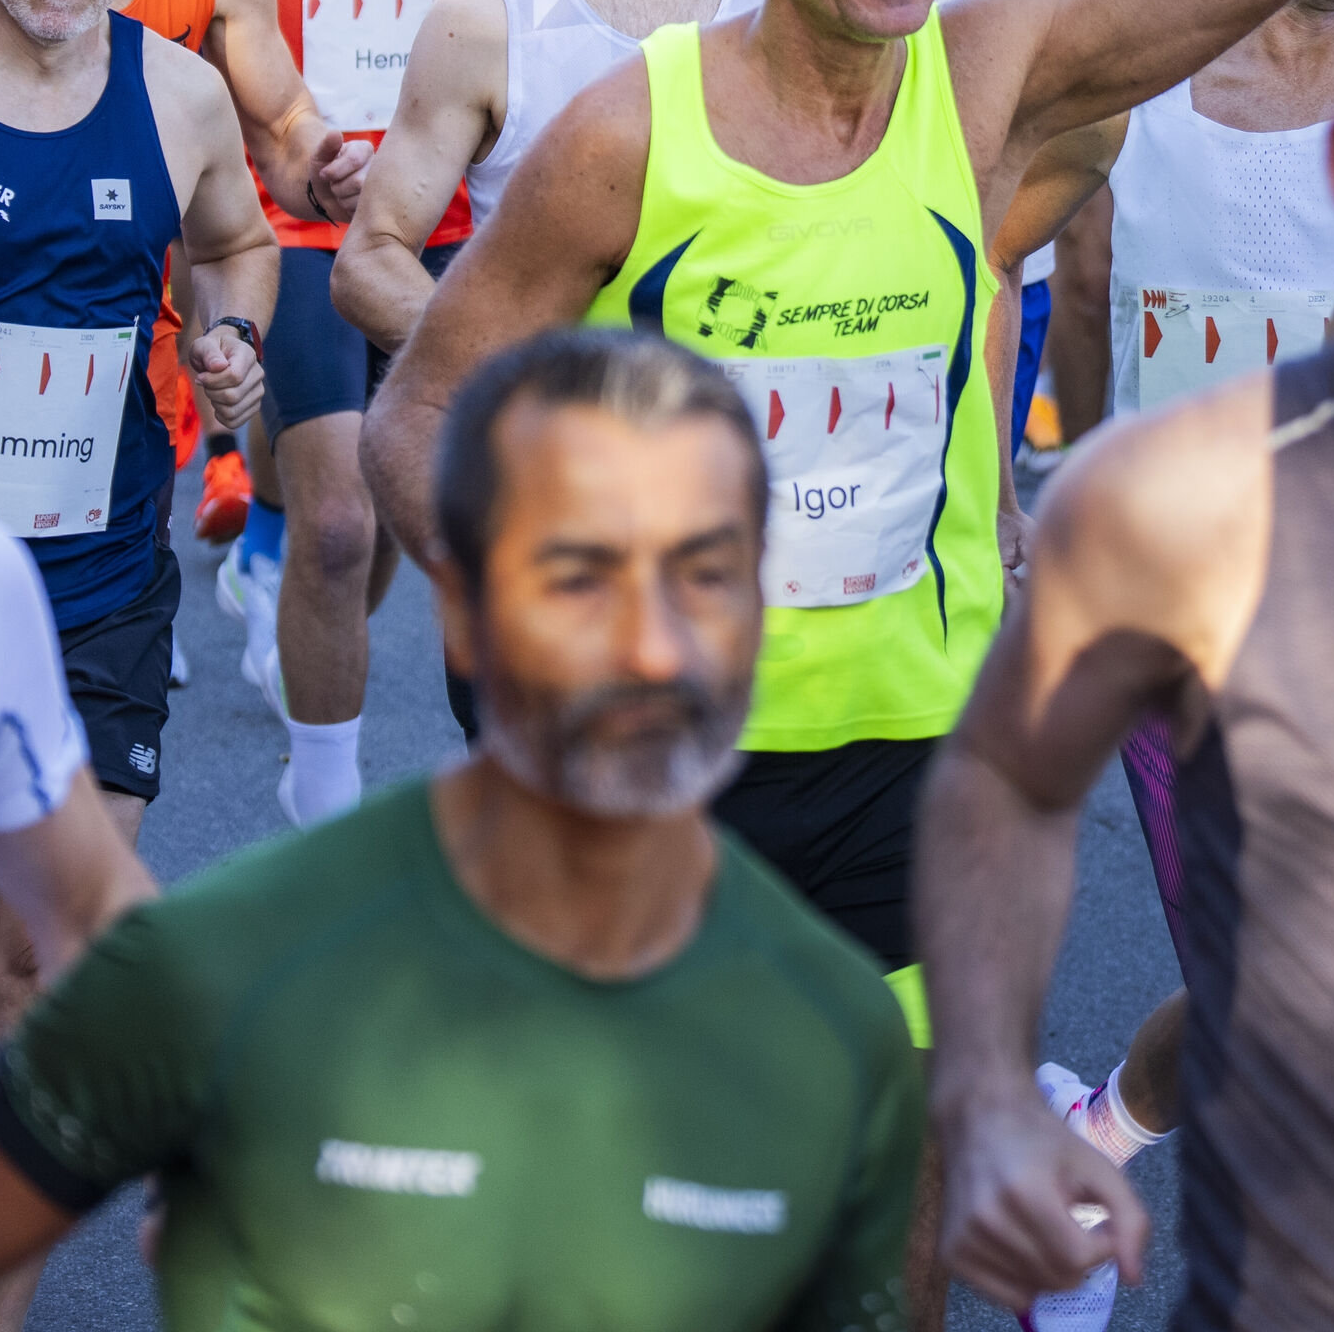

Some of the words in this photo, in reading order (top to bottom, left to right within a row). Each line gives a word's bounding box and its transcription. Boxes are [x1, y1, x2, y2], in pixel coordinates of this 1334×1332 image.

[768, 217, 875, 243] GIVOVA
[776, 300, 853, 326] SEMPRE
[855, 298, 876, 317] DI
[877, 290, 930, 314] CORSA
[1202, 294, 1231, 303] 19204
[1308, 295, 1326, 303] DEN
[833, 316, 880, 338] TEAM
[793, 482, 861, 520] Igor
[34, 520, 58, 528] WORLD
